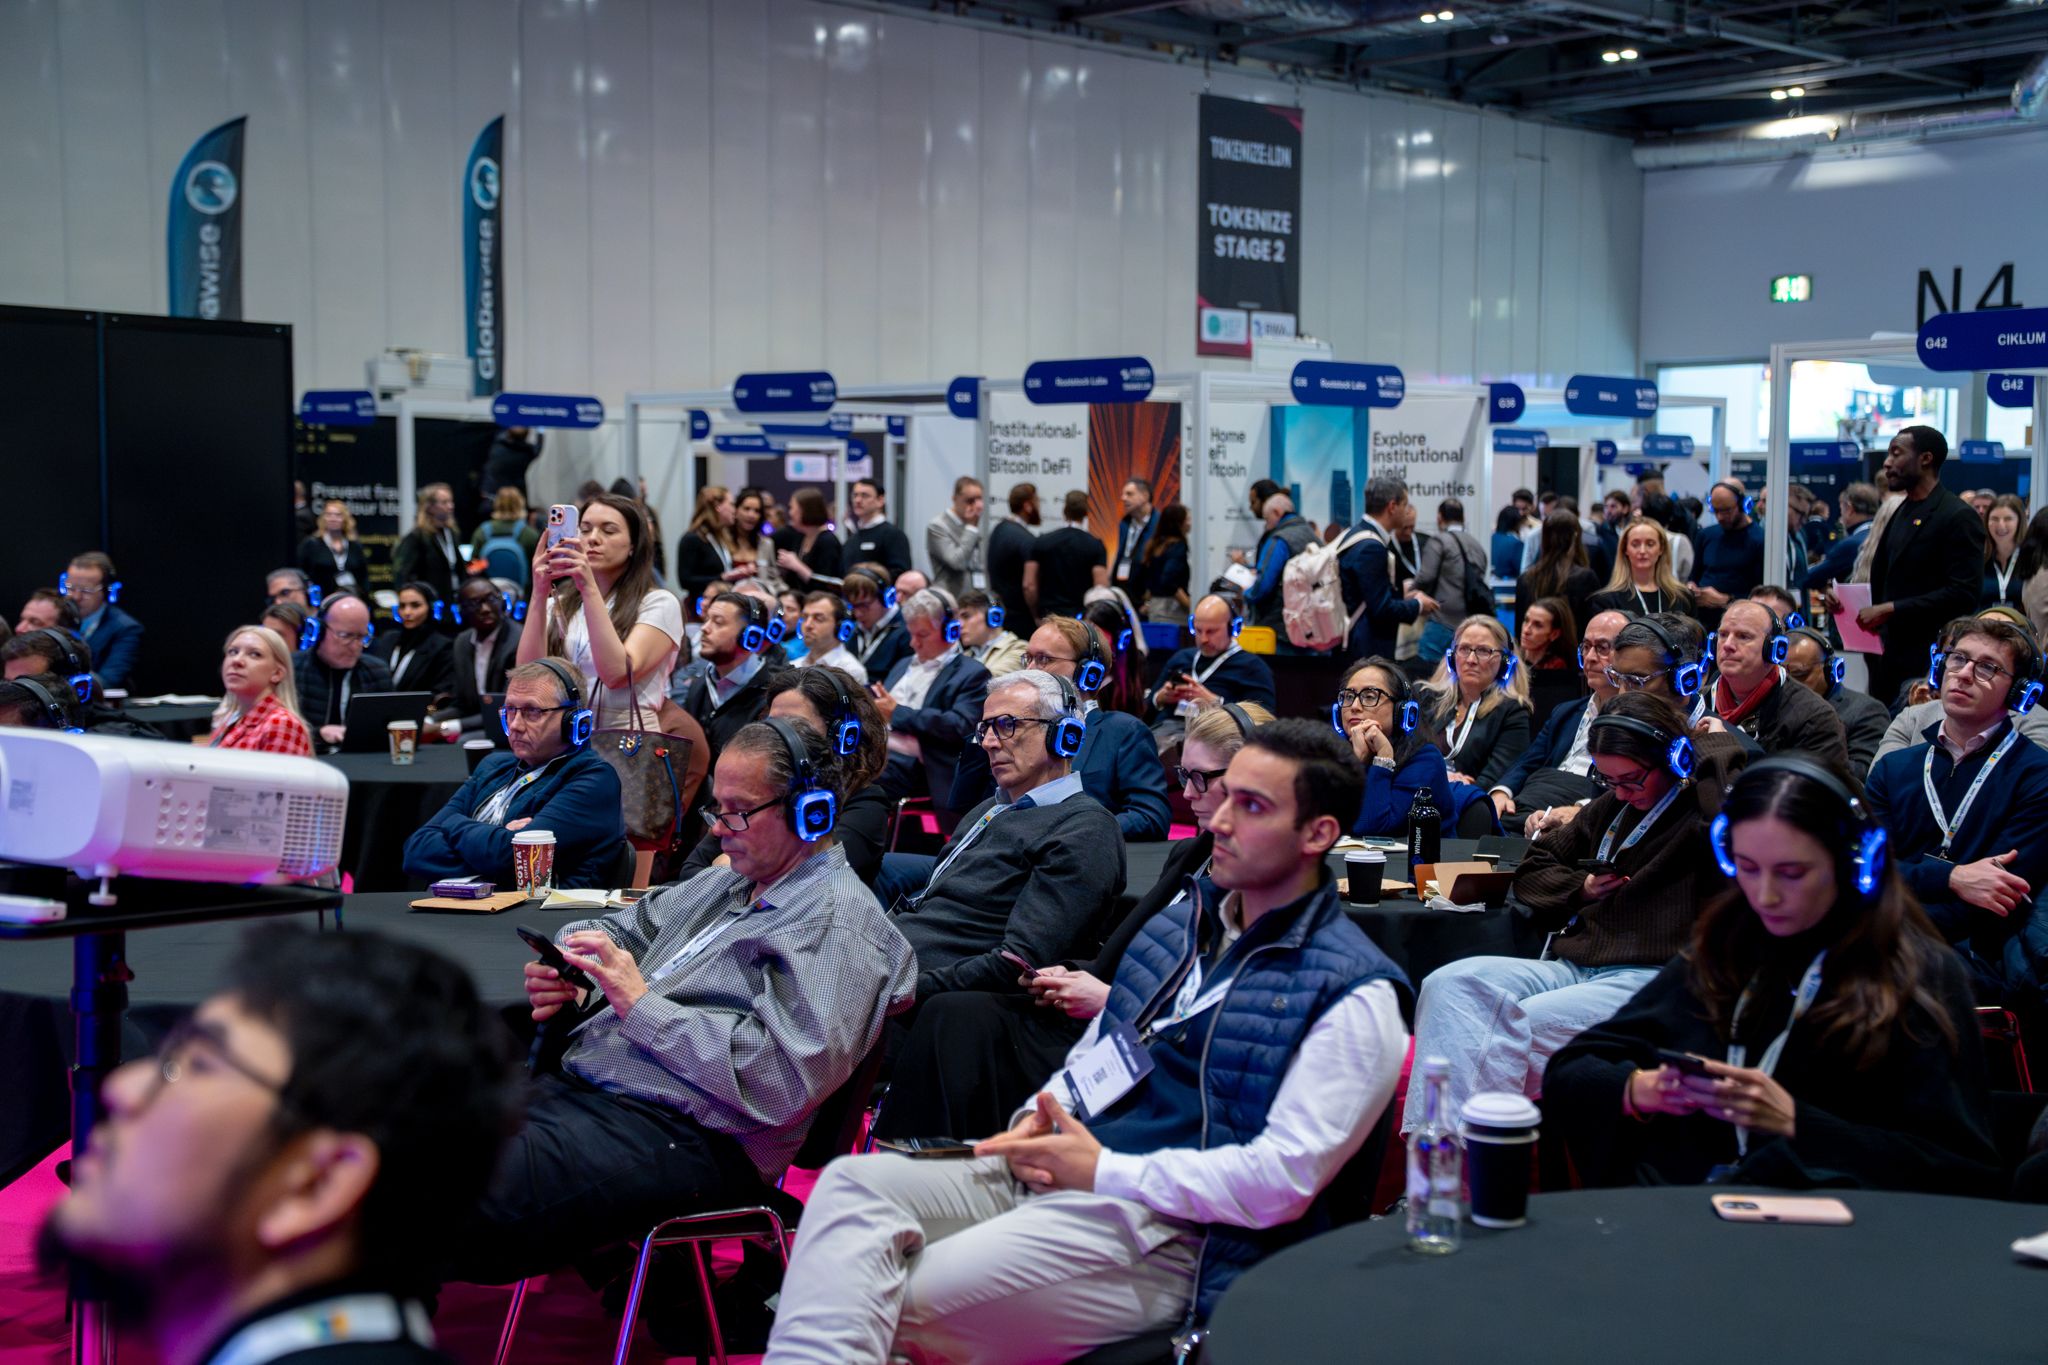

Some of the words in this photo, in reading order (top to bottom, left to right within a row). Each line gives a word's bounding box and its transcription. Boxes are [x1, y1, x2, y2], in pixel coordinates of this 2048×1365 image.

[1208, 203, 1292, 234] TOKENIZE
[1214, 234, 1272, 262] STAGE
[1273, 239, 1286, 263] 2
[199, 223, 220, 320] awise
[1925, 337, 1948, 350] G42
[1998, 332, 2046, 346] CIKLUM
[1091, 375, 1108, 386] Labs
[2002, 379, 2024, 391] G42
[989, 421, 1082, 439] Institutional-
[1210, 427, 1246, 443] Home
[989, 439, 1031, 456] Grade
[1373, 431, 1426, 448] Explore
[1209, 445, 1226, 460] eFi
[1373, 448, 1464, 463] institutional
[989, 458, 1039, 474] Bitcoin
[1041, 458, 1072, 475] DeFi
[311, 482, 372, 500] Prevent
[373, 483, 398, 500] fra
[1408, 481, 1475, 497] rtunities
[1414, 826, 1422, 855] Whisper
[516, 850, 524, 886] COSTA
